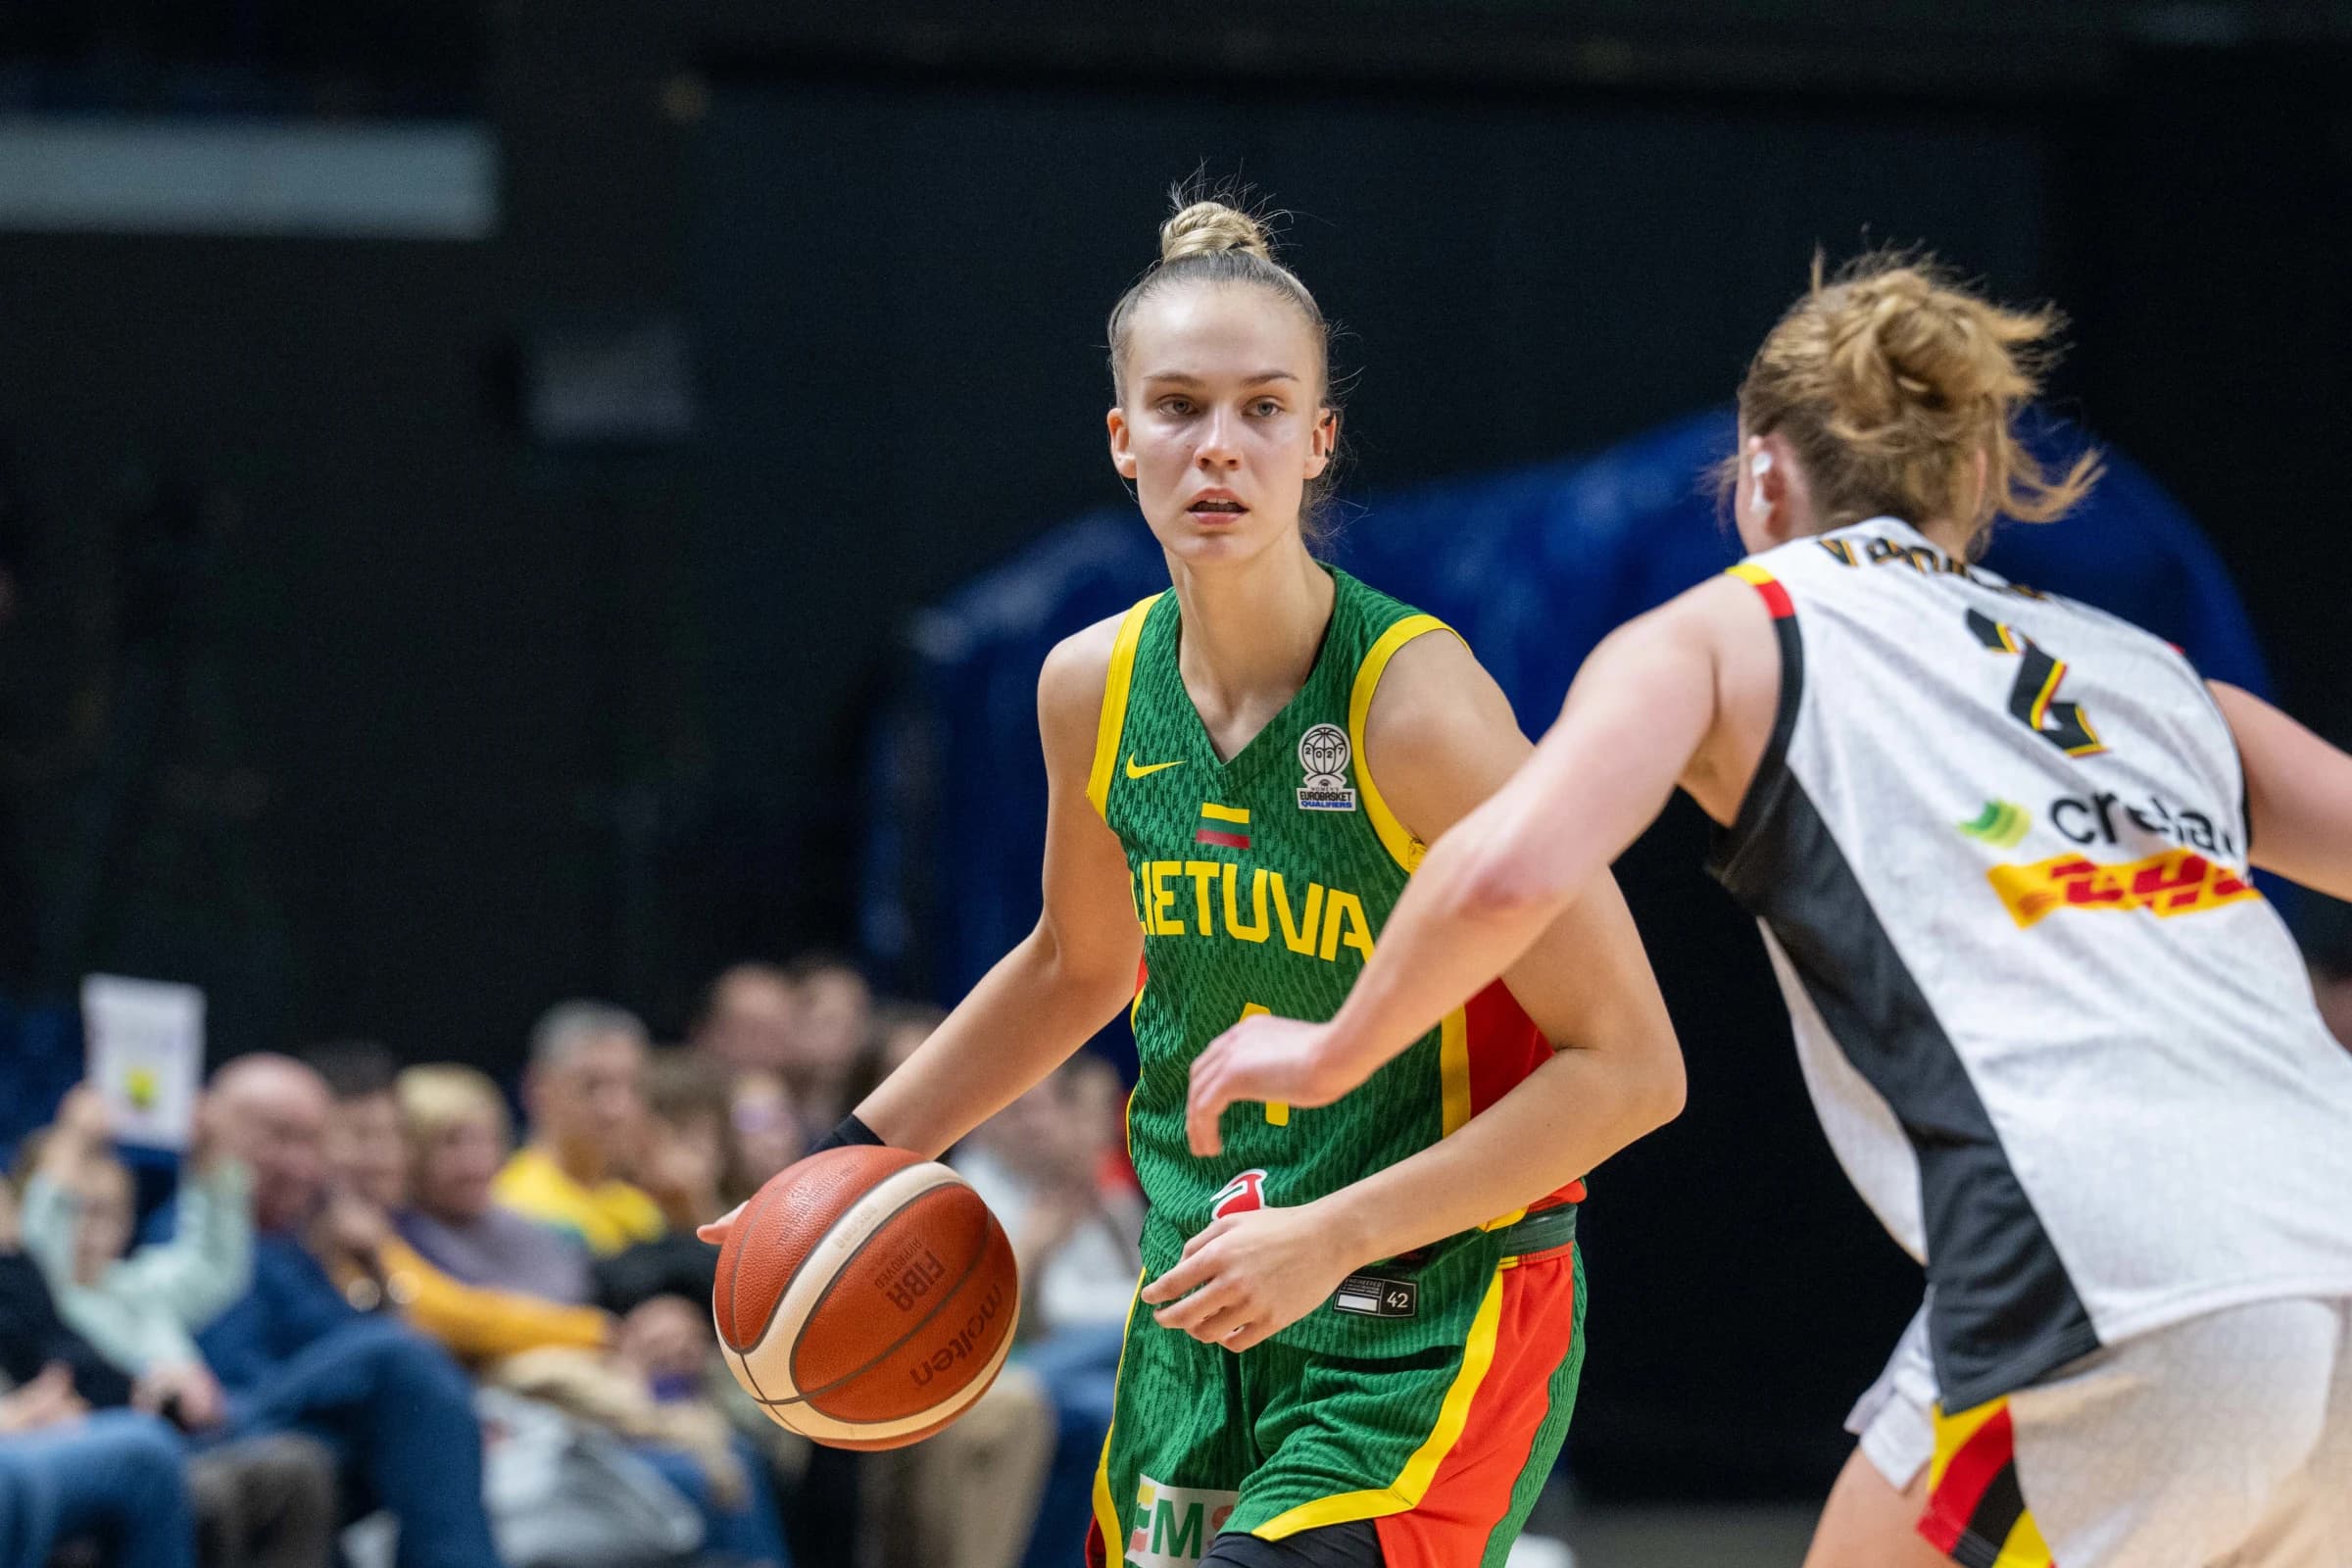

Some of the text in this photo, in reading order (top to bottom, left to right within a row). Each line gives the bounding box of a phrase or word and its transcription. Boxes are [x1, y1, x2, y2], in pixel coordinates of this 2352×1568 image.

[1966, 608, 2109, 758] 2
[1299, 791, 1352, 802] EUROBASKET
[1301, 800, 1352, 808] QUALIFIERS
[886, 1250, 947, 1312] FIBA
[1387, 1291, 1409, 1308] 42
[909, 1283, 1004, 1387] molten
